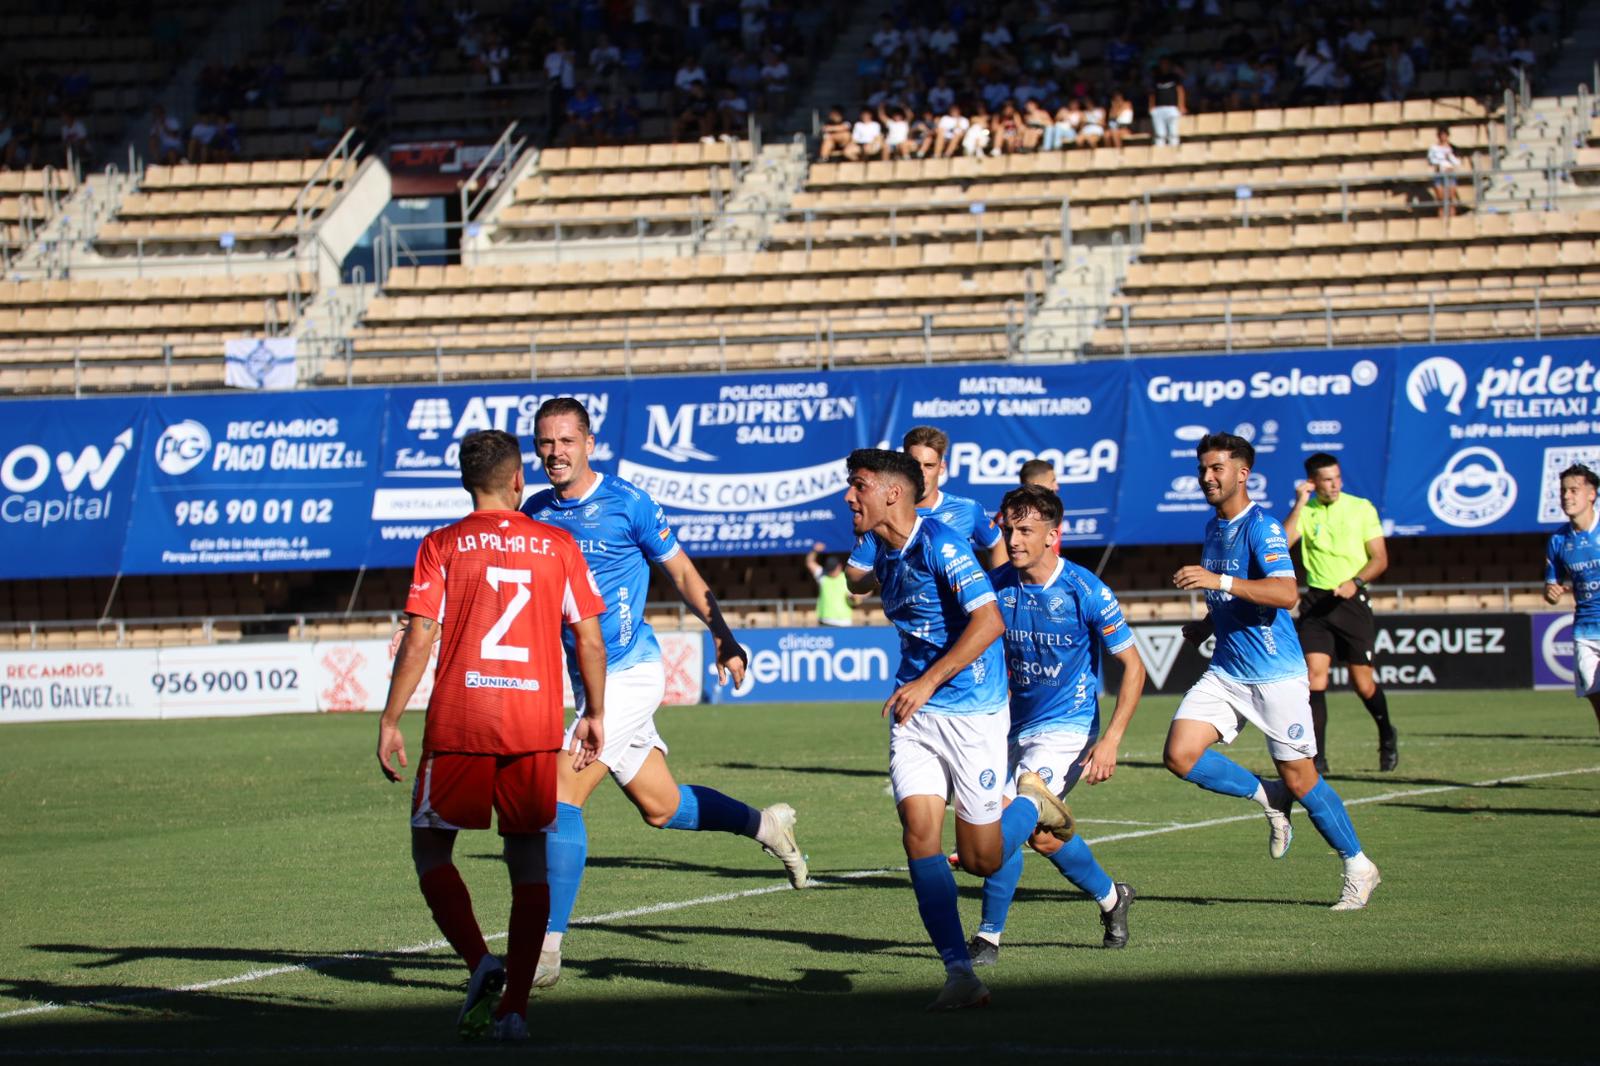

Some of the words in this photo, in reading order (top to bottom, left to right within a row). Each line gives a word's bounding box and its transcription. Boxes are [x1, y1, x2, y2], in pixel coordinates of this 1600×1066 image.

[959, 376, 1047, 395] MATERIAL
[1147, 376, 1246, 407] Grupo
[1249, 368, 1351, 398] Solera
[912, 397, 981, 418] MÉDICO
[982, 399, 997, 416] Y
[997, 396, 1092, 416] SANITARIO
[1491, 397, 1587, 418] TELETAXI
[226, 418, 340, 441] RECAMBIOS
[642, 396, 857, 461] MEDIPREVEN
[736, 424, 805, 444] SALUD
[212, 441, 265, 471] PACO
[270, 438, 346, 469] GALVEZ
[716, 482, 772, 507] CON
[774, 467, 850, 503] GANA
[1, 491, 112, 528] Capital
[175, 502, 218, 527] 956
[226, 500, 257, 524] 90
[263, 500, 293, 524] 01
[301, 499, 333, 523] 02
[457, 534, 477, 552] LA
[480, 533, 526, 554] PALMA
[530, 538, 556, 557] C.F.
[577, 539, 608, 552] ELS
[480, 566, 532, 663] 2
[1006, 629, 1073, 647] HIPOTELS
[1374, 627, 1505, 655] AZQUEZ
[7, 663, 104, 679] RECAMBIOS
[1, 685, 44, 710] PACO
[50, 683, 114, 708] GALVEZ
